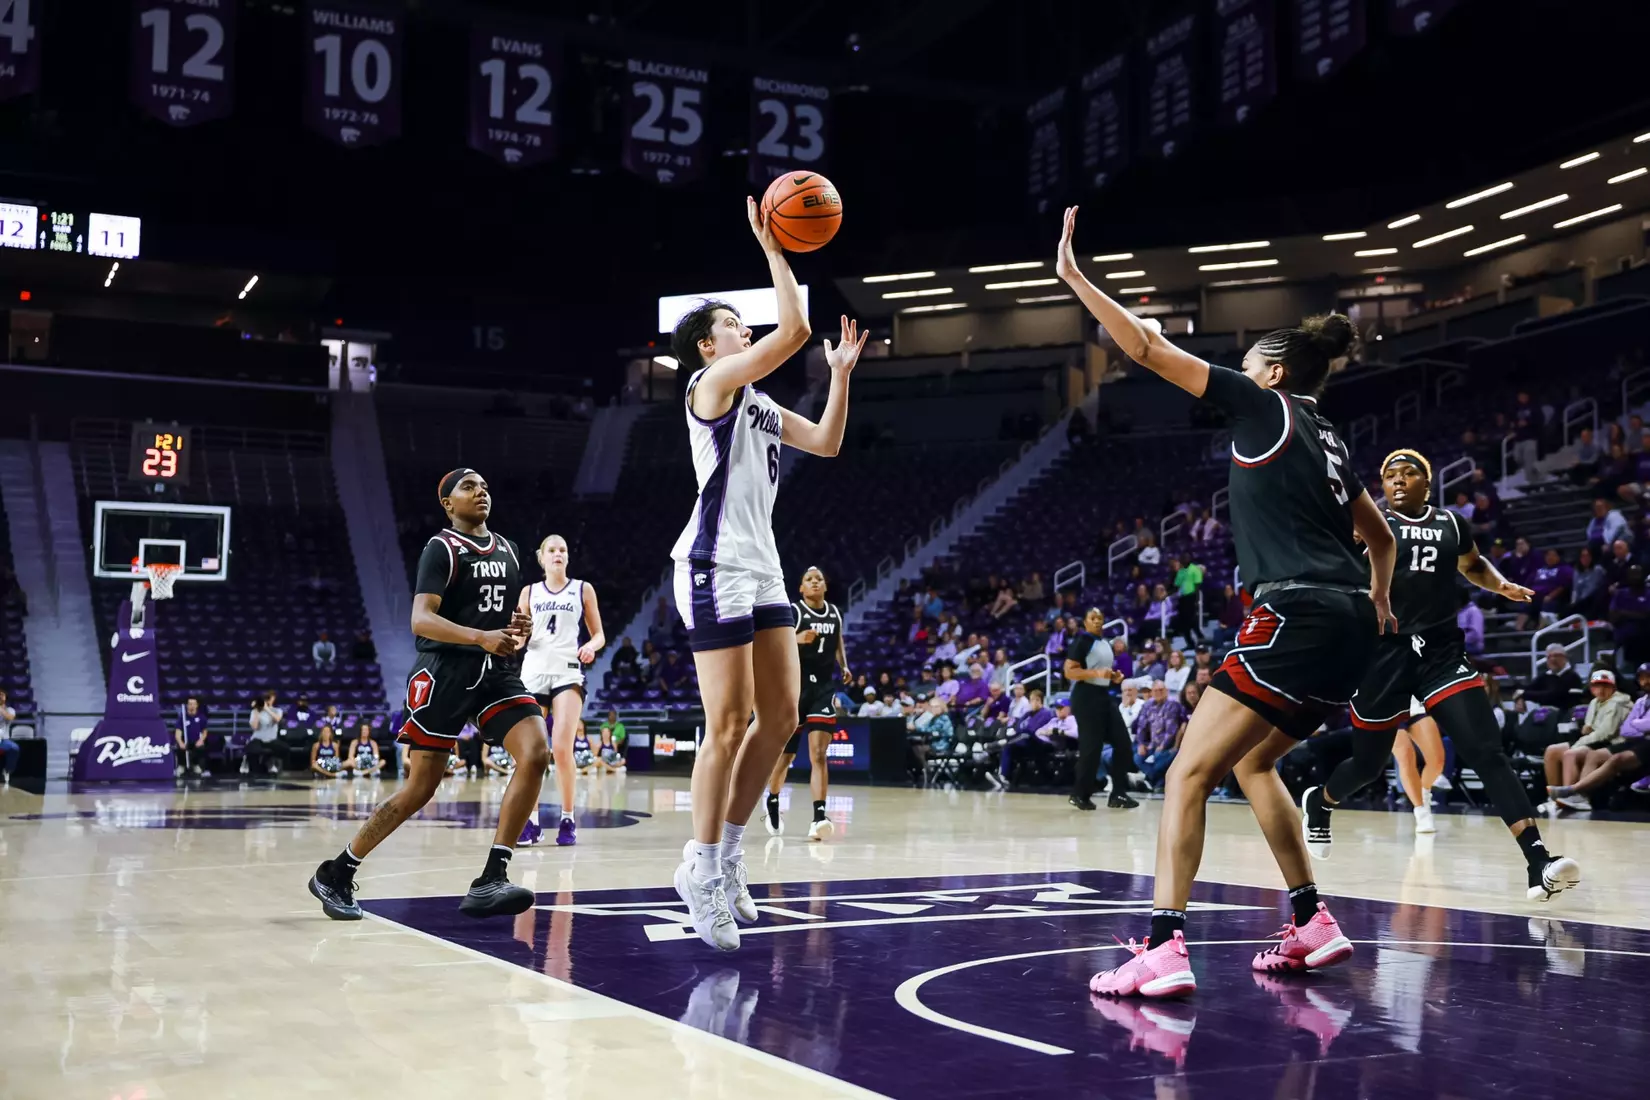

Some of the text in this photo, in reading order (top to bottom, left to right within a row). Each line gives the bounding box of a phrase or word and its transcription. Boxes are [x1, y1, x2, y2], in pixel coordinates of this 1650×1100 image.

[312, 9, 395, 34] WILLIAMS
[140, 8, 225, 81] 12
[492, 36, 543, 58] EVANS
[313, 34, 392, 103] 10
[627, 59, 709, 83] BLACKMAN
[151, 84, 210, 103] 1971-74
[480, 58, 552, 126] 12
[753, 77, 830, 100] RICHMOND
[631, 81, 703, 146] 25
[757, 98, 825, 161] 23
[802, 193, 841, 208] ELITE
[101, 230, 125, 248] 11
[472, 325, 505, 351] 15
[747, 404, 782, 440] Wild
[143, 448, 178, 477] 23
[767, 442, 779, 485] 6
[1323, 449, 1350, 506] 5
[1399, 525, 1443, 541] TROY
[470, 561, 507, 578] TROY
[1409, 545, 1438, 572] 12
[478, 584, 507, 612] 35
[534, 601, 574, 613] Wildcats
[546, 614, 556, 635] 4
[809, 622, 835, 634] TROY
[817, 637, 825, 653] 1
[117, 693, 154, 702] Channel
[94, 735, 170, 767] Dillons
